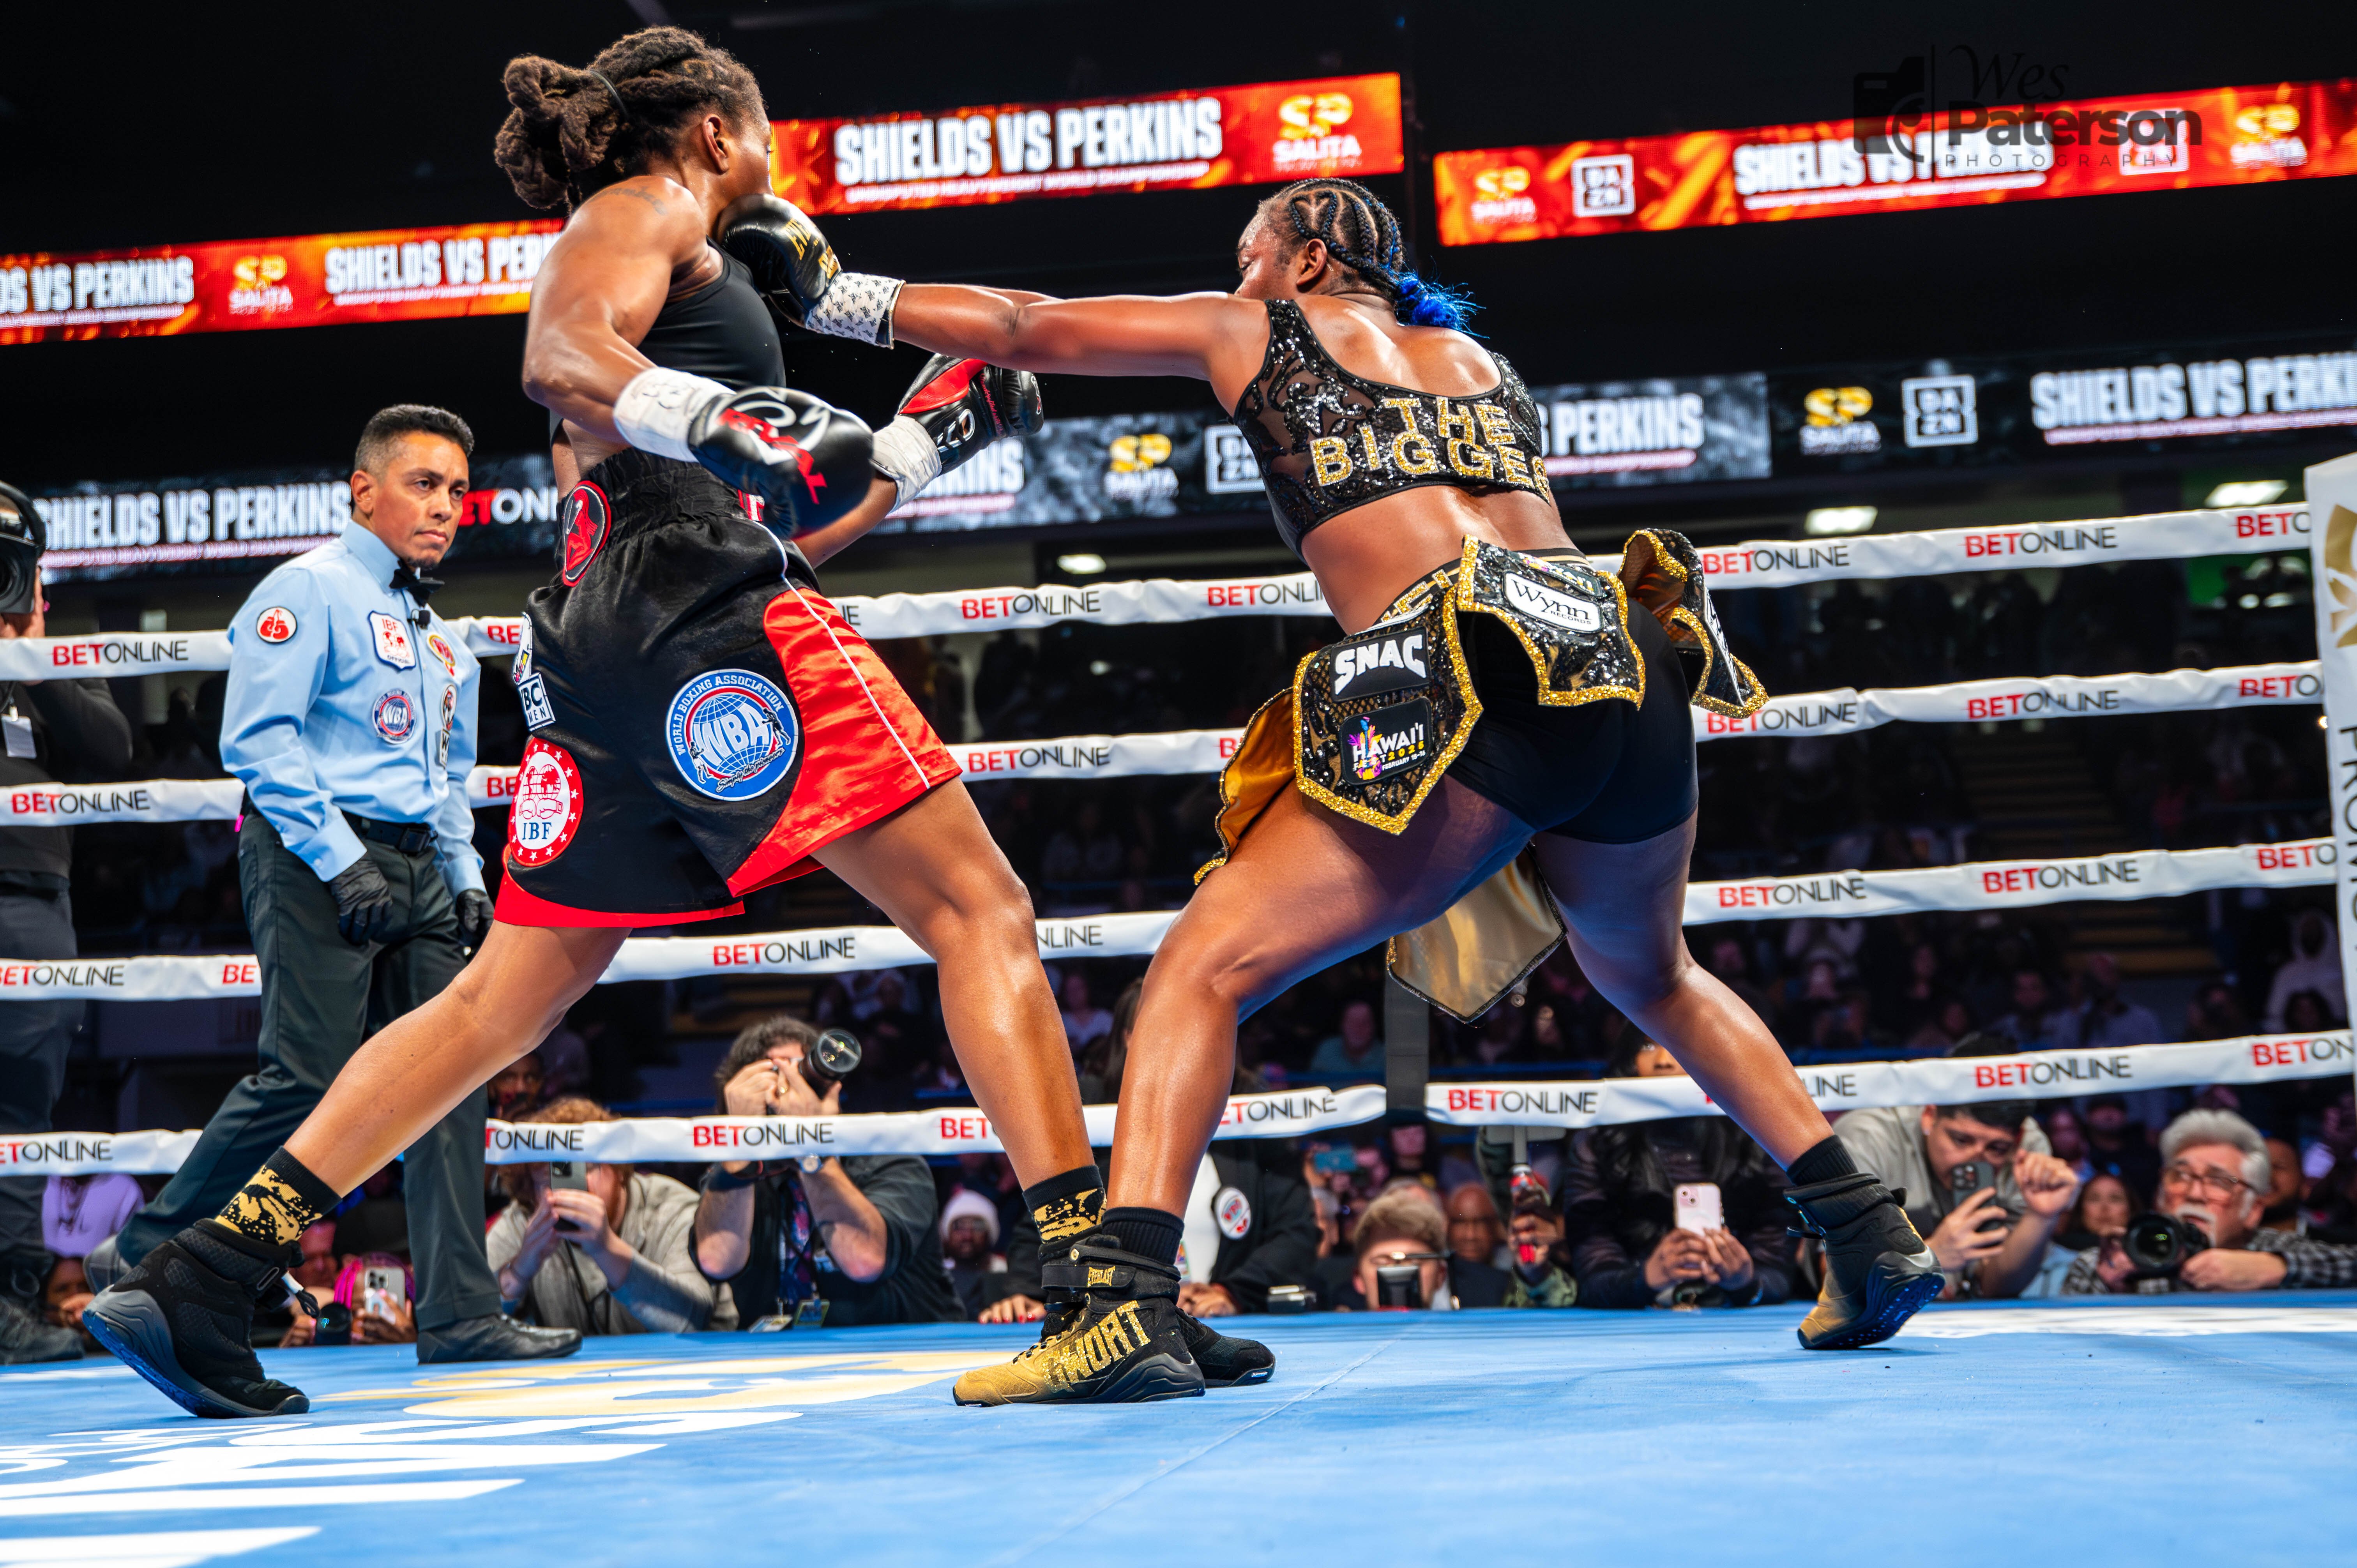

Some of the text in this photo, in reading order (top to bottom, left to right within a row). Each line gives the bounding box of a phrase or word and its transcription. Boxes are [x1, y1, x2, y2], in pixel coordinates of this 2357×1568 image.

[834, 116, 992, 186] SHIELDS
[996, 110, 1052, 173] VS
[1055, 96, 1224, 168] PERKINS
[1733, 136, 1866, 196] SHIELDS
[325, 239, 442, 294] SHIELDS
[443, 237, 484, 284] VS
[31, 263, 72, 311] VS
[73, 255, 194, 309] PERKINS
[2030, 362, 2188, 430] SHIELDS
[2186, 358, 2246, 418] VS
[1383, 396, 1516, 445] THE
[1550, 392, 1705, 456] PERKINS
[162, 488, 211, 544] VS
[213, 480, 352, 541] PERKINS
[1965, 526, 2117, 557] BETONLINE
[1703, 546, 1849, 574] BETONLINE
[961, 591, 1101, 620] BETONLINE
[1511, 579, 1594, 620] Wynn
[382, 618, 398, 631] IBF
[1551, 610, 1591, 625] RECORDS
[52, 639, 189, 666] BETONLINE
[1334, 634, 1427, 695] SNAC
[521, 682, 543, 711] BC
[1969, 690, 2119, 720] BETONLINE
[382, 705, 408, 724] WBA
[671, 675, 784, 756] WORLD BOXING ASSOCIATION
[1707, 702, 1856, 734] BETONLINE
[692, 702, 770, 767] WBA
[969, 745, 1110, 773] BETONLINE
[1382, 756, 1410, 771] FEBRUARY
[12, 789, 150, 814] BETONLINE
[522, 822, 552, 840] IBF
[1719, 877, 1867, 908] BETONLINE
[1984, 861, 2140, 893] BETONLINE
[713, 936, 855, 966] BETONLINE
[1975, 1055, 2133, 1088] BETONLINE
[1448, 1089, 1597, 1113] BETONLINE
[694, 1121, 834, 1147] BETONLINE
[942, 1117, 994, 1139] BET
